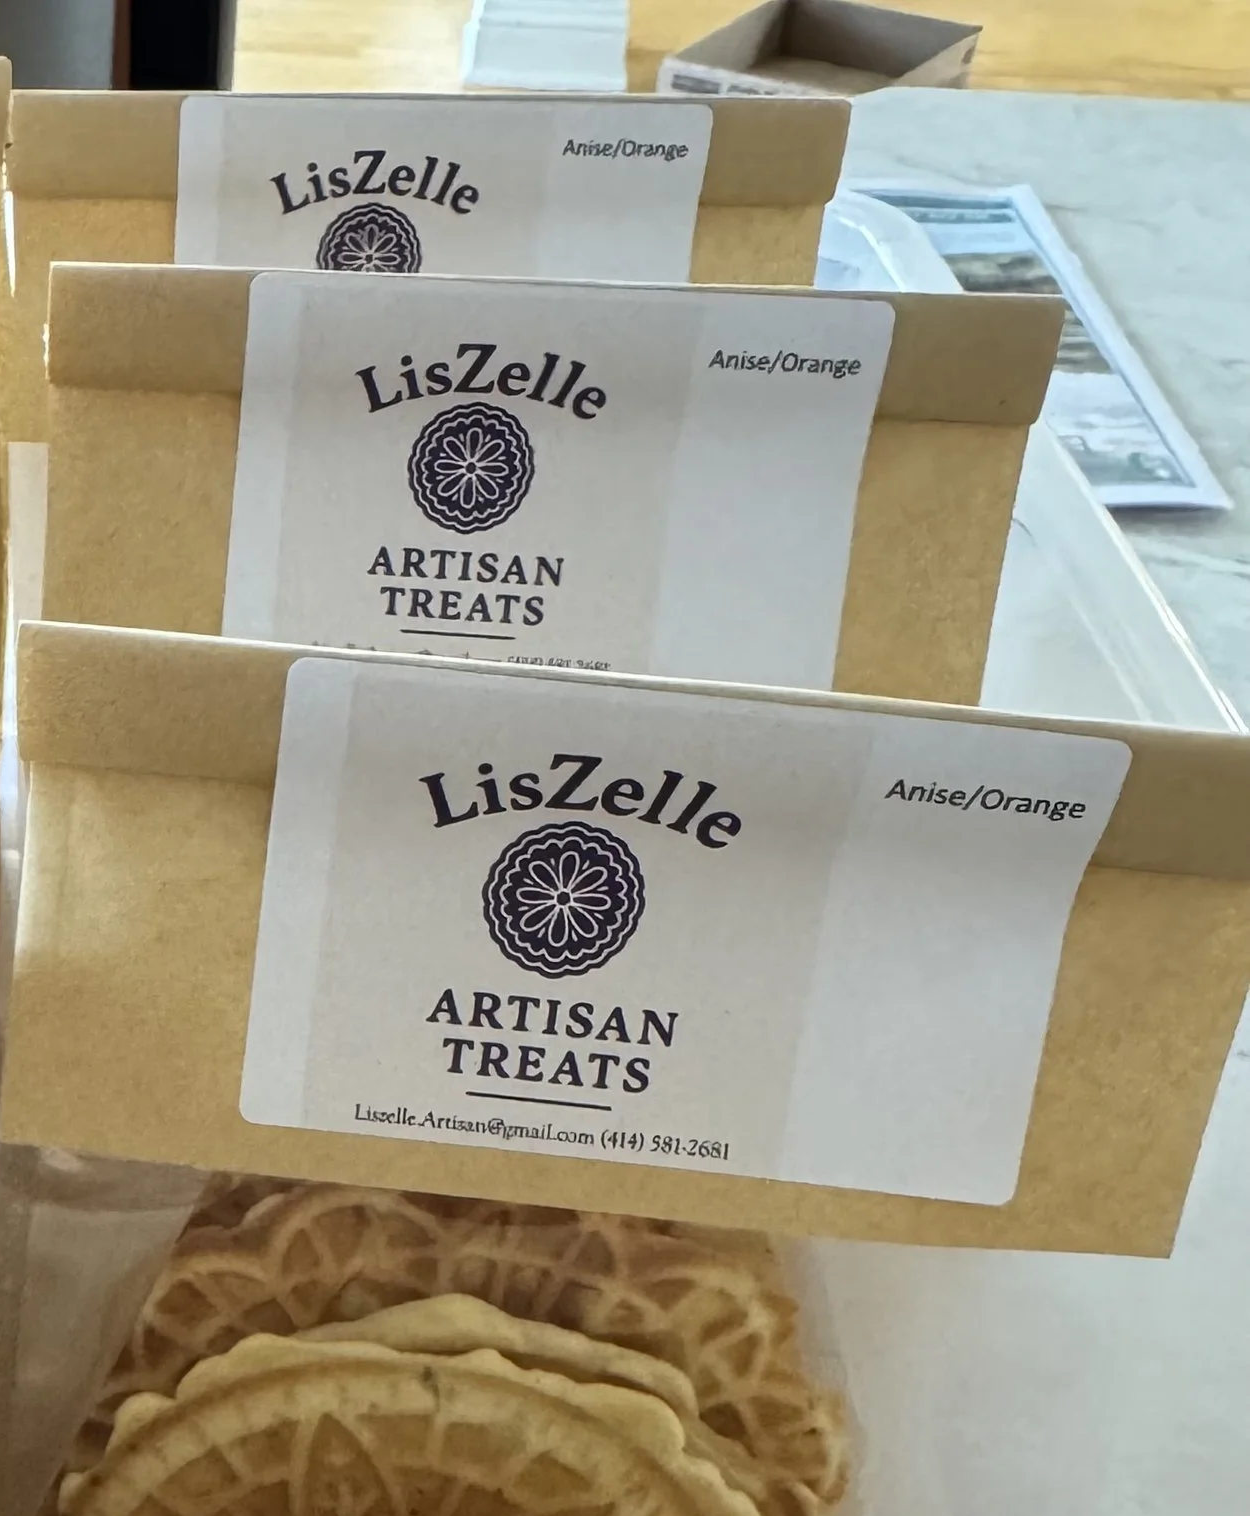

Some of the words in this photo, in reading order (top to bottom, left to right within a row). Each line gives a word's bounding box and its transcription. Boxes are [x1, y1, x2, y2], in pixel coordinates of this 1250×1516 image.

[563, 139, 688, 162] Anise/Orange
[269, 150, 480, 214] LisZelle
[355, 344, 607, 421] LisZelle
[709, 350, 861, 379] Anise/Orange
[367, 546, 564, 587] ARTISAN
[380, 586, 543, 626] TREATS
[419, 754, 742, 851] LisZelle
[885, 780, 1086, 821] Anise/Orange
[426, 989, 678, 1048] ARTISAN
[443, 1037, 651, 1094] TREATS
[601, 1130, 644, 1152] (414)
[650, 1135, 728, 1160] 581-2681
